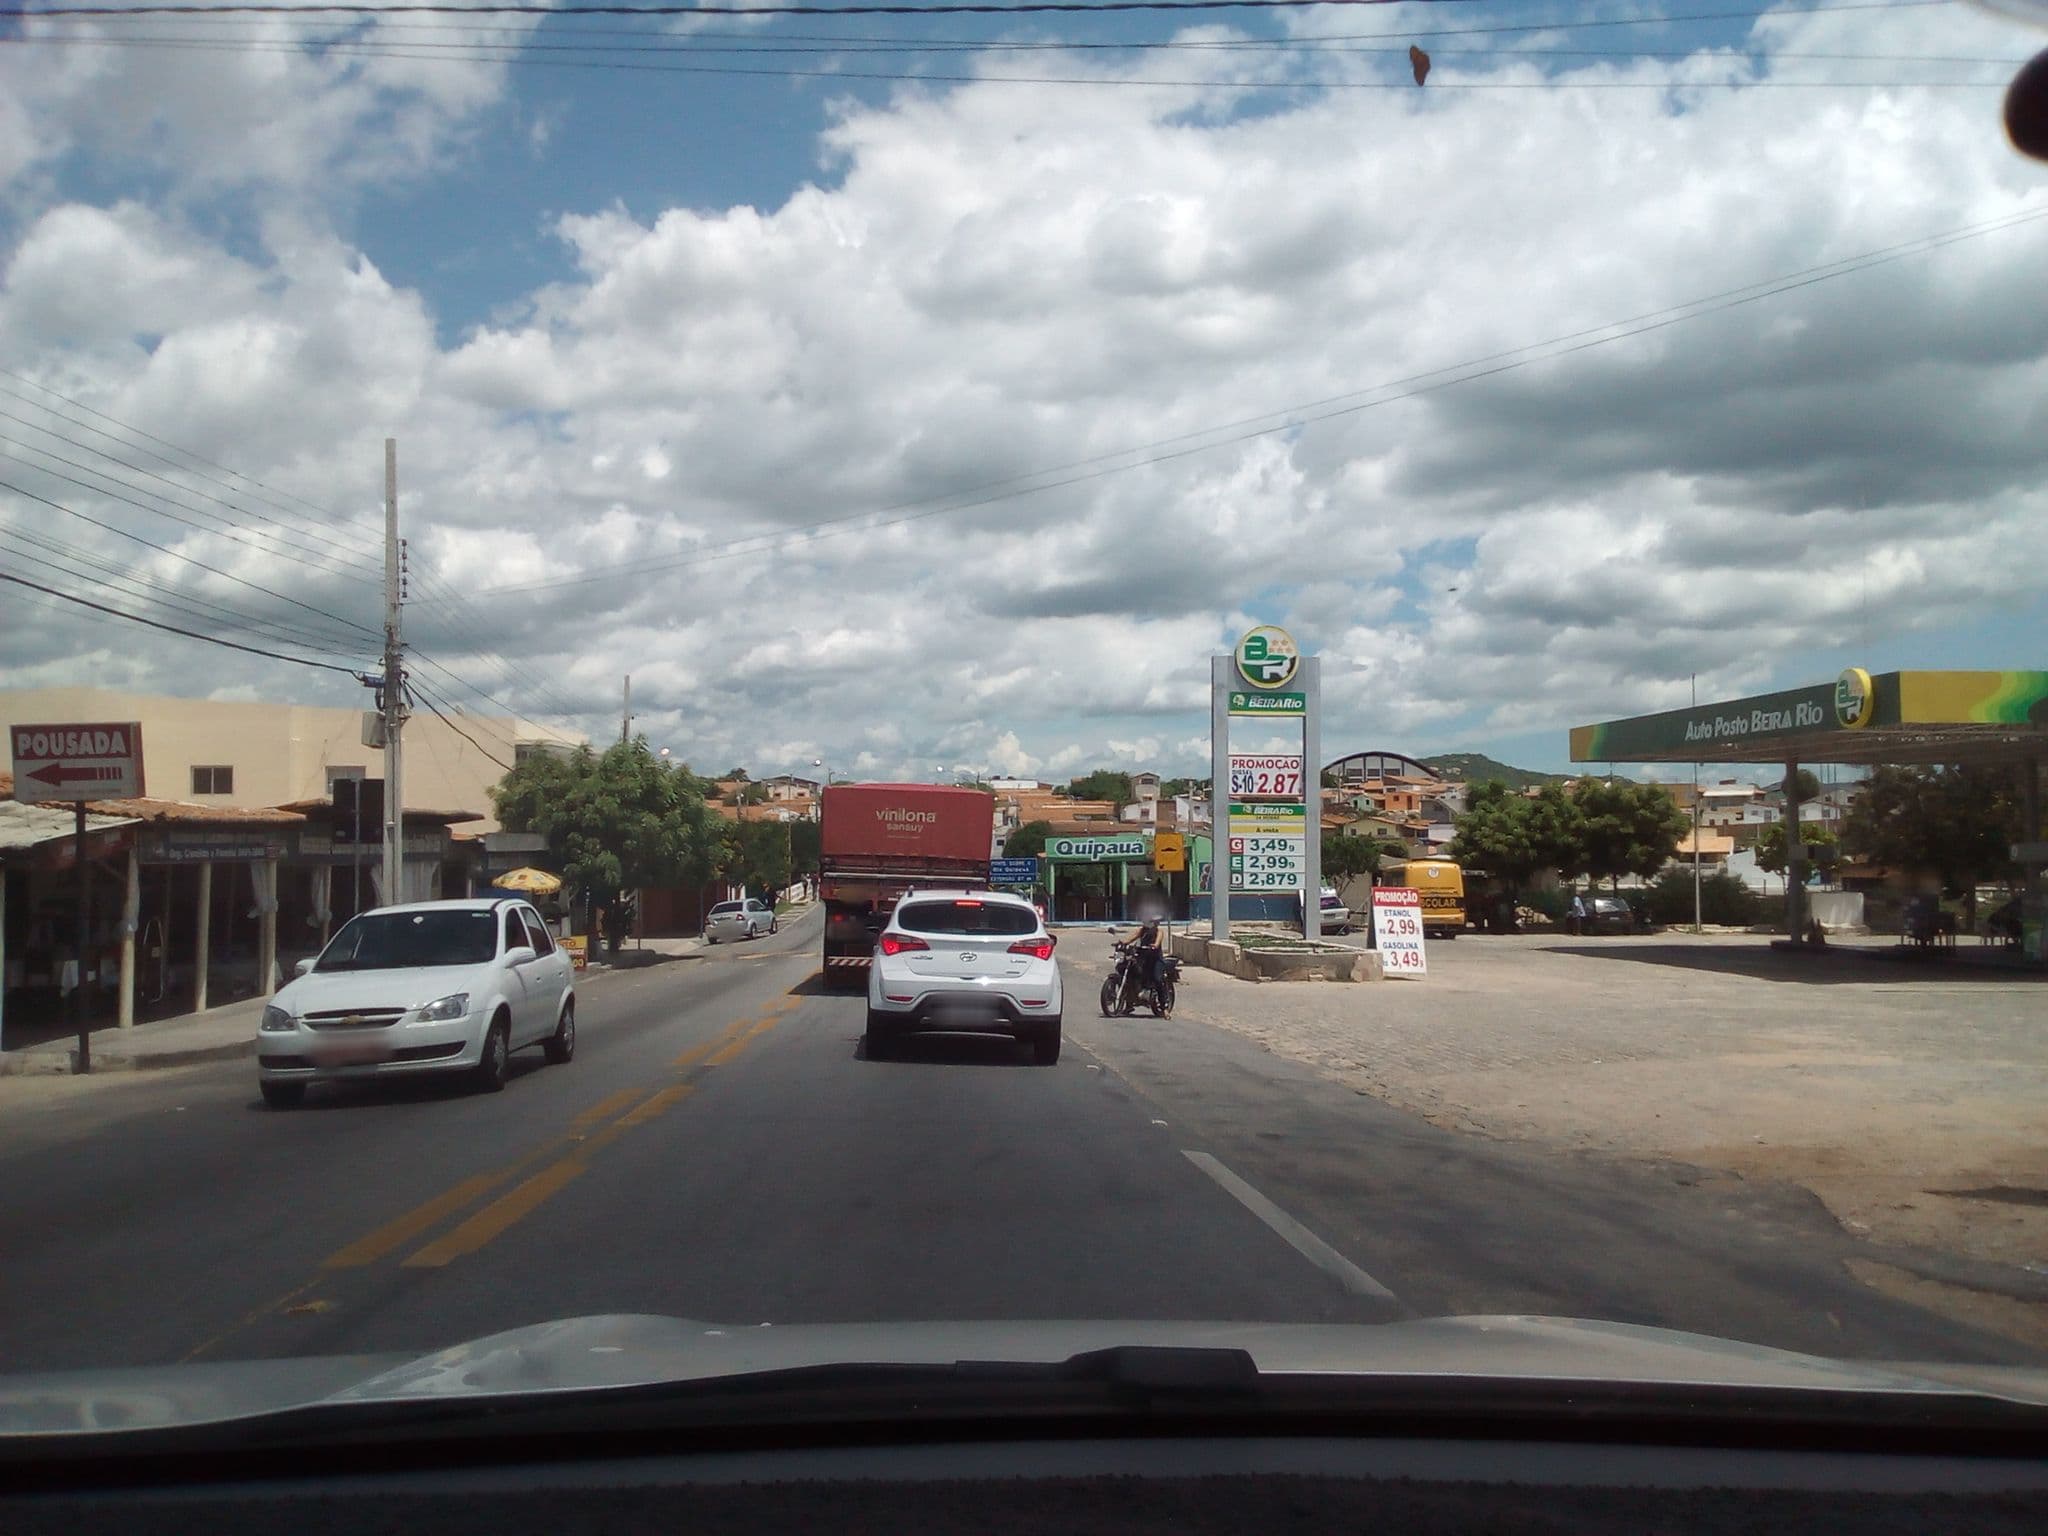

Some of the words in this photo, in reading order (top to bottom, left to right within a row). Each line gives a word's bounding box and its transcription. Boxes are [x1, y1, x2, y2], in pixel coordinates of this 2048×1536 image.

[1685, 721, 1712, 741] Auto
[1714, 715, 1747, 737] Posto
[1751, 709, 1792, 733] BEIRA
[1795, 701, 1823, 727] Rio
[18, 731, 127, 756] POUSADA
[875, 807, 937, 823] vinilona
[886, 823, 924, 833] sansuy
[1055, 838, 1144, 861] Quipauá
[1231, 839, 1243, 850] G
[1231, 856, 1242, 867] E
[1232, 873, 1242, 884] D
[1248, 873, 1297, 886] 2,879
[1375, 890, 1418, 905] PROMOÇÃO
[1421, 898, 1456, 907] SCOLAR
[1384, 909, 1411, 917] ETANOL
